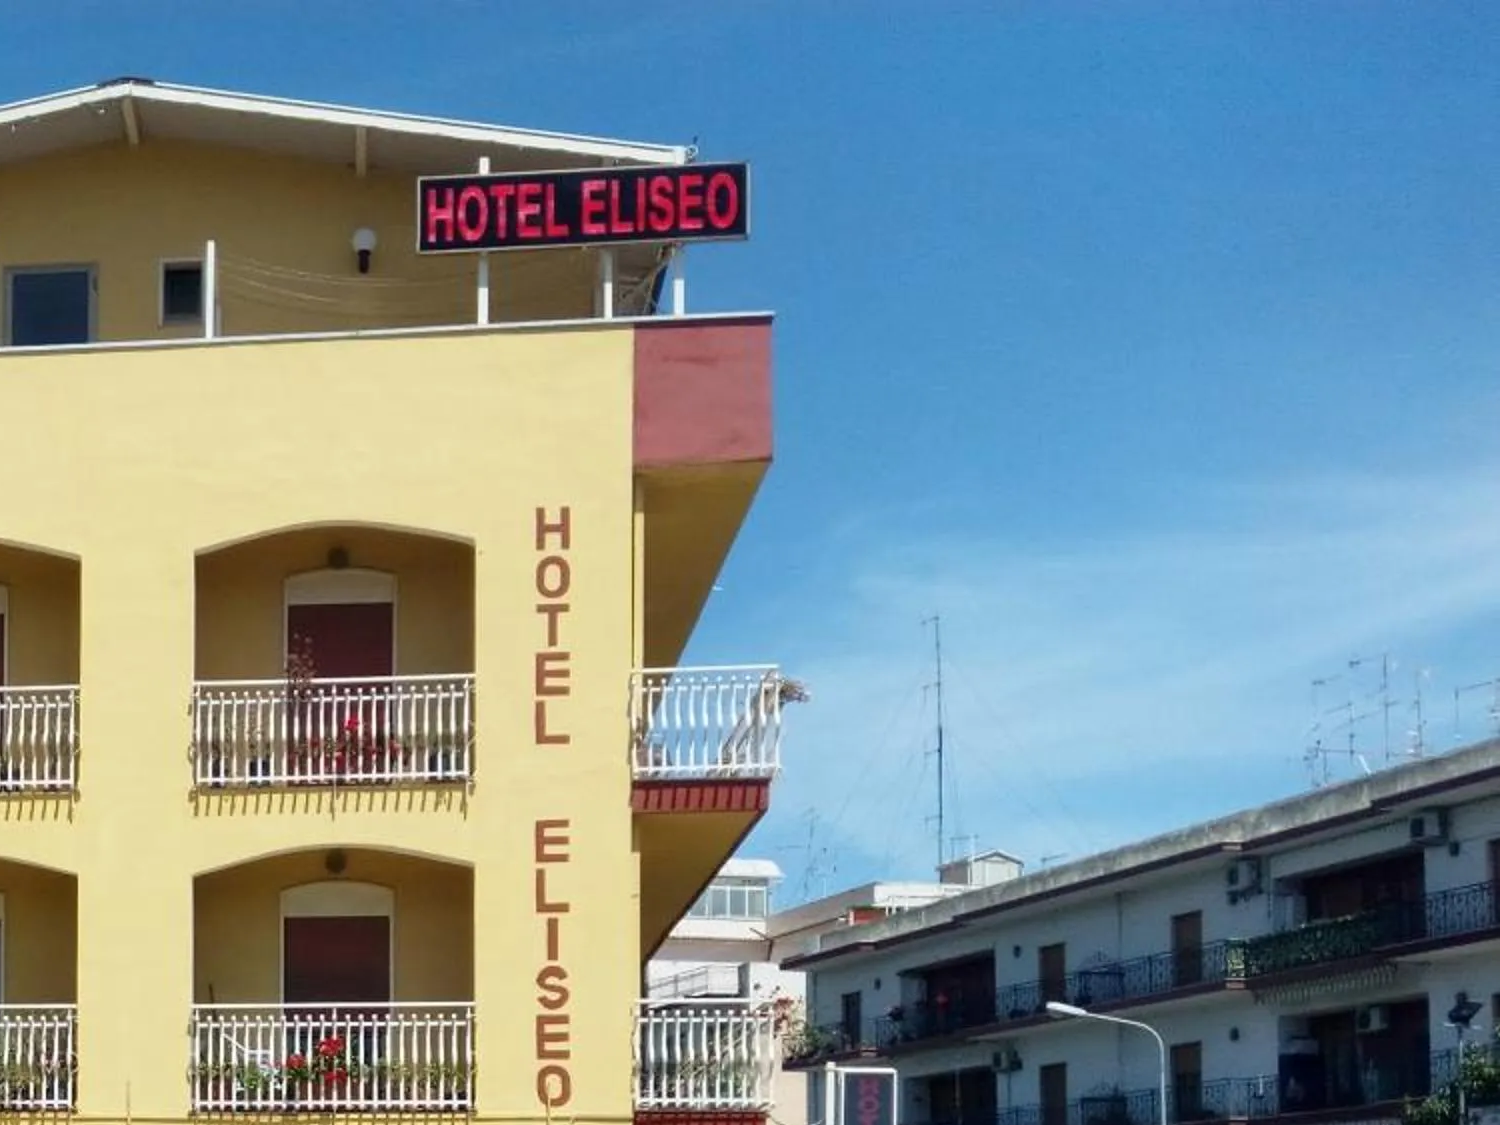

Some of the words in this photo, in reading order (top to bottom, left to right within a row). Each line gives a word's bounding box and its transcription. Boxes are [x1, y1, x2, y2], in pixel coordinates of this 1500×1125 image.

[426, 182, 569, 243] HOTEL
[581, 171, 739, 235] ELISEO
[535, 506, 570, 745] HOTEL
[535, 818, 571, 1107] ELISEO
